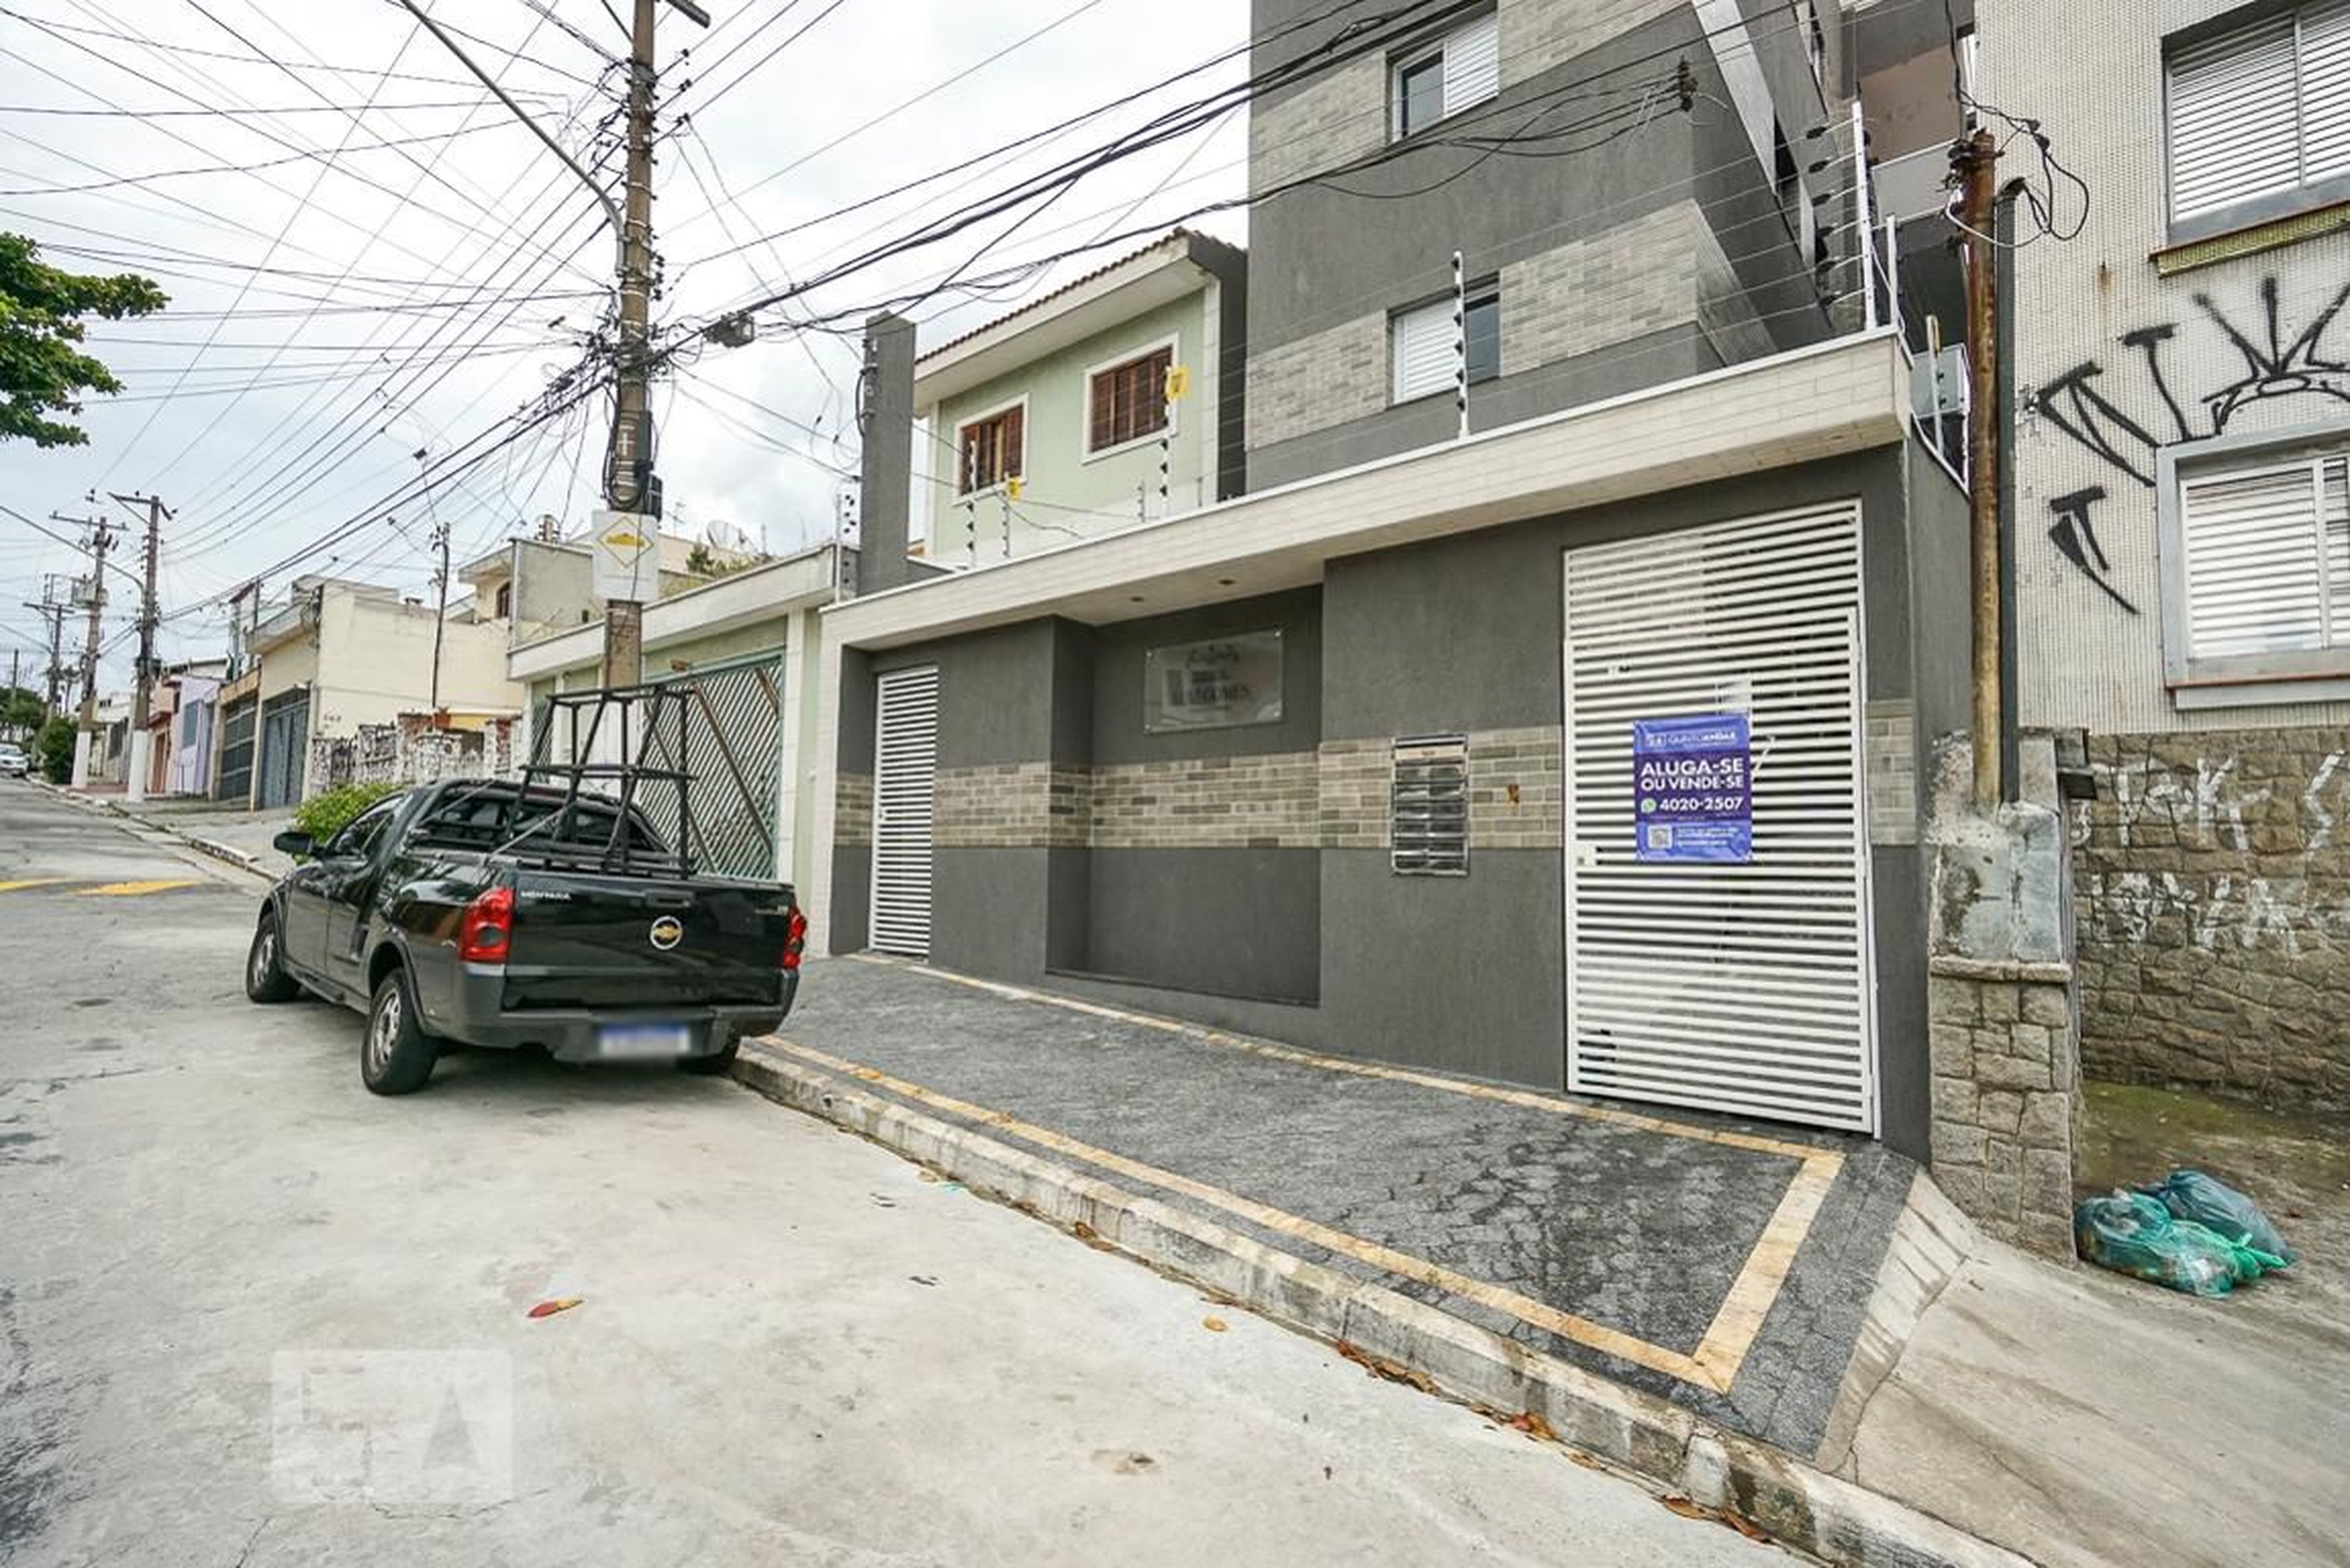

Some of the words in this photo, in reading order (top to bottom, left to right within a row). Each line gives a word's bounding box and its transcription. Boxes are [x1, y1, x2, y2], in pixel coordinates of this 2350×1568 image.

[1641, 758, 1744, 776] ALUGA-SE
[1641, 778, 1665, 791] OU
[1669, 776, 1744, 790] VENDE-SE
[1660, 797, 1744, 811] 4020-2507
